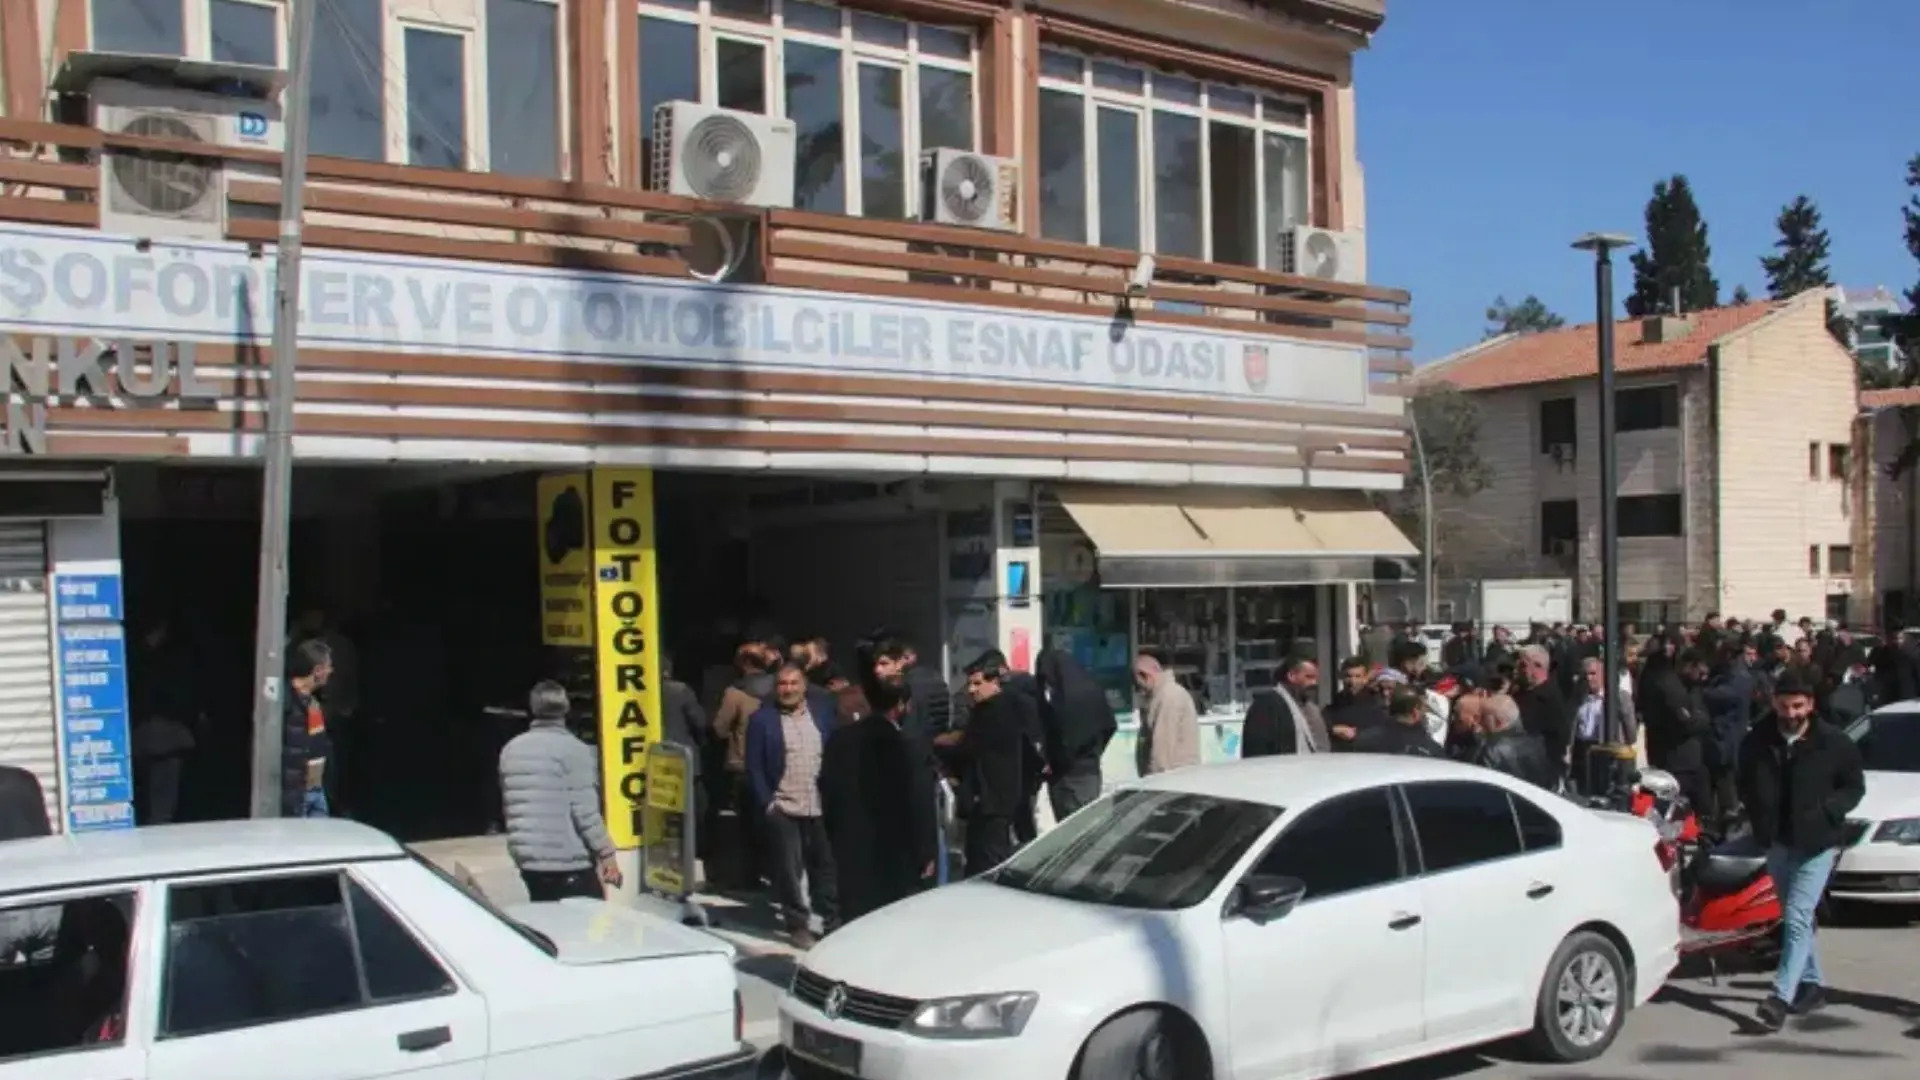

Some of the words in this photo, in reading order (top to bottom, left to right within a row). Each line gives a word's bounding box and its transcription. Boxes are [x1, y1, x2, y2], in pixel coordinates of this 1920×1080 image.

[0, 247, 397, 327] ŞOFÖRER
[405, 276, 493, 335] VE
[947, 319, 1093, 371] ESNAF
[1107, 333, 1226, 382] ODASI
